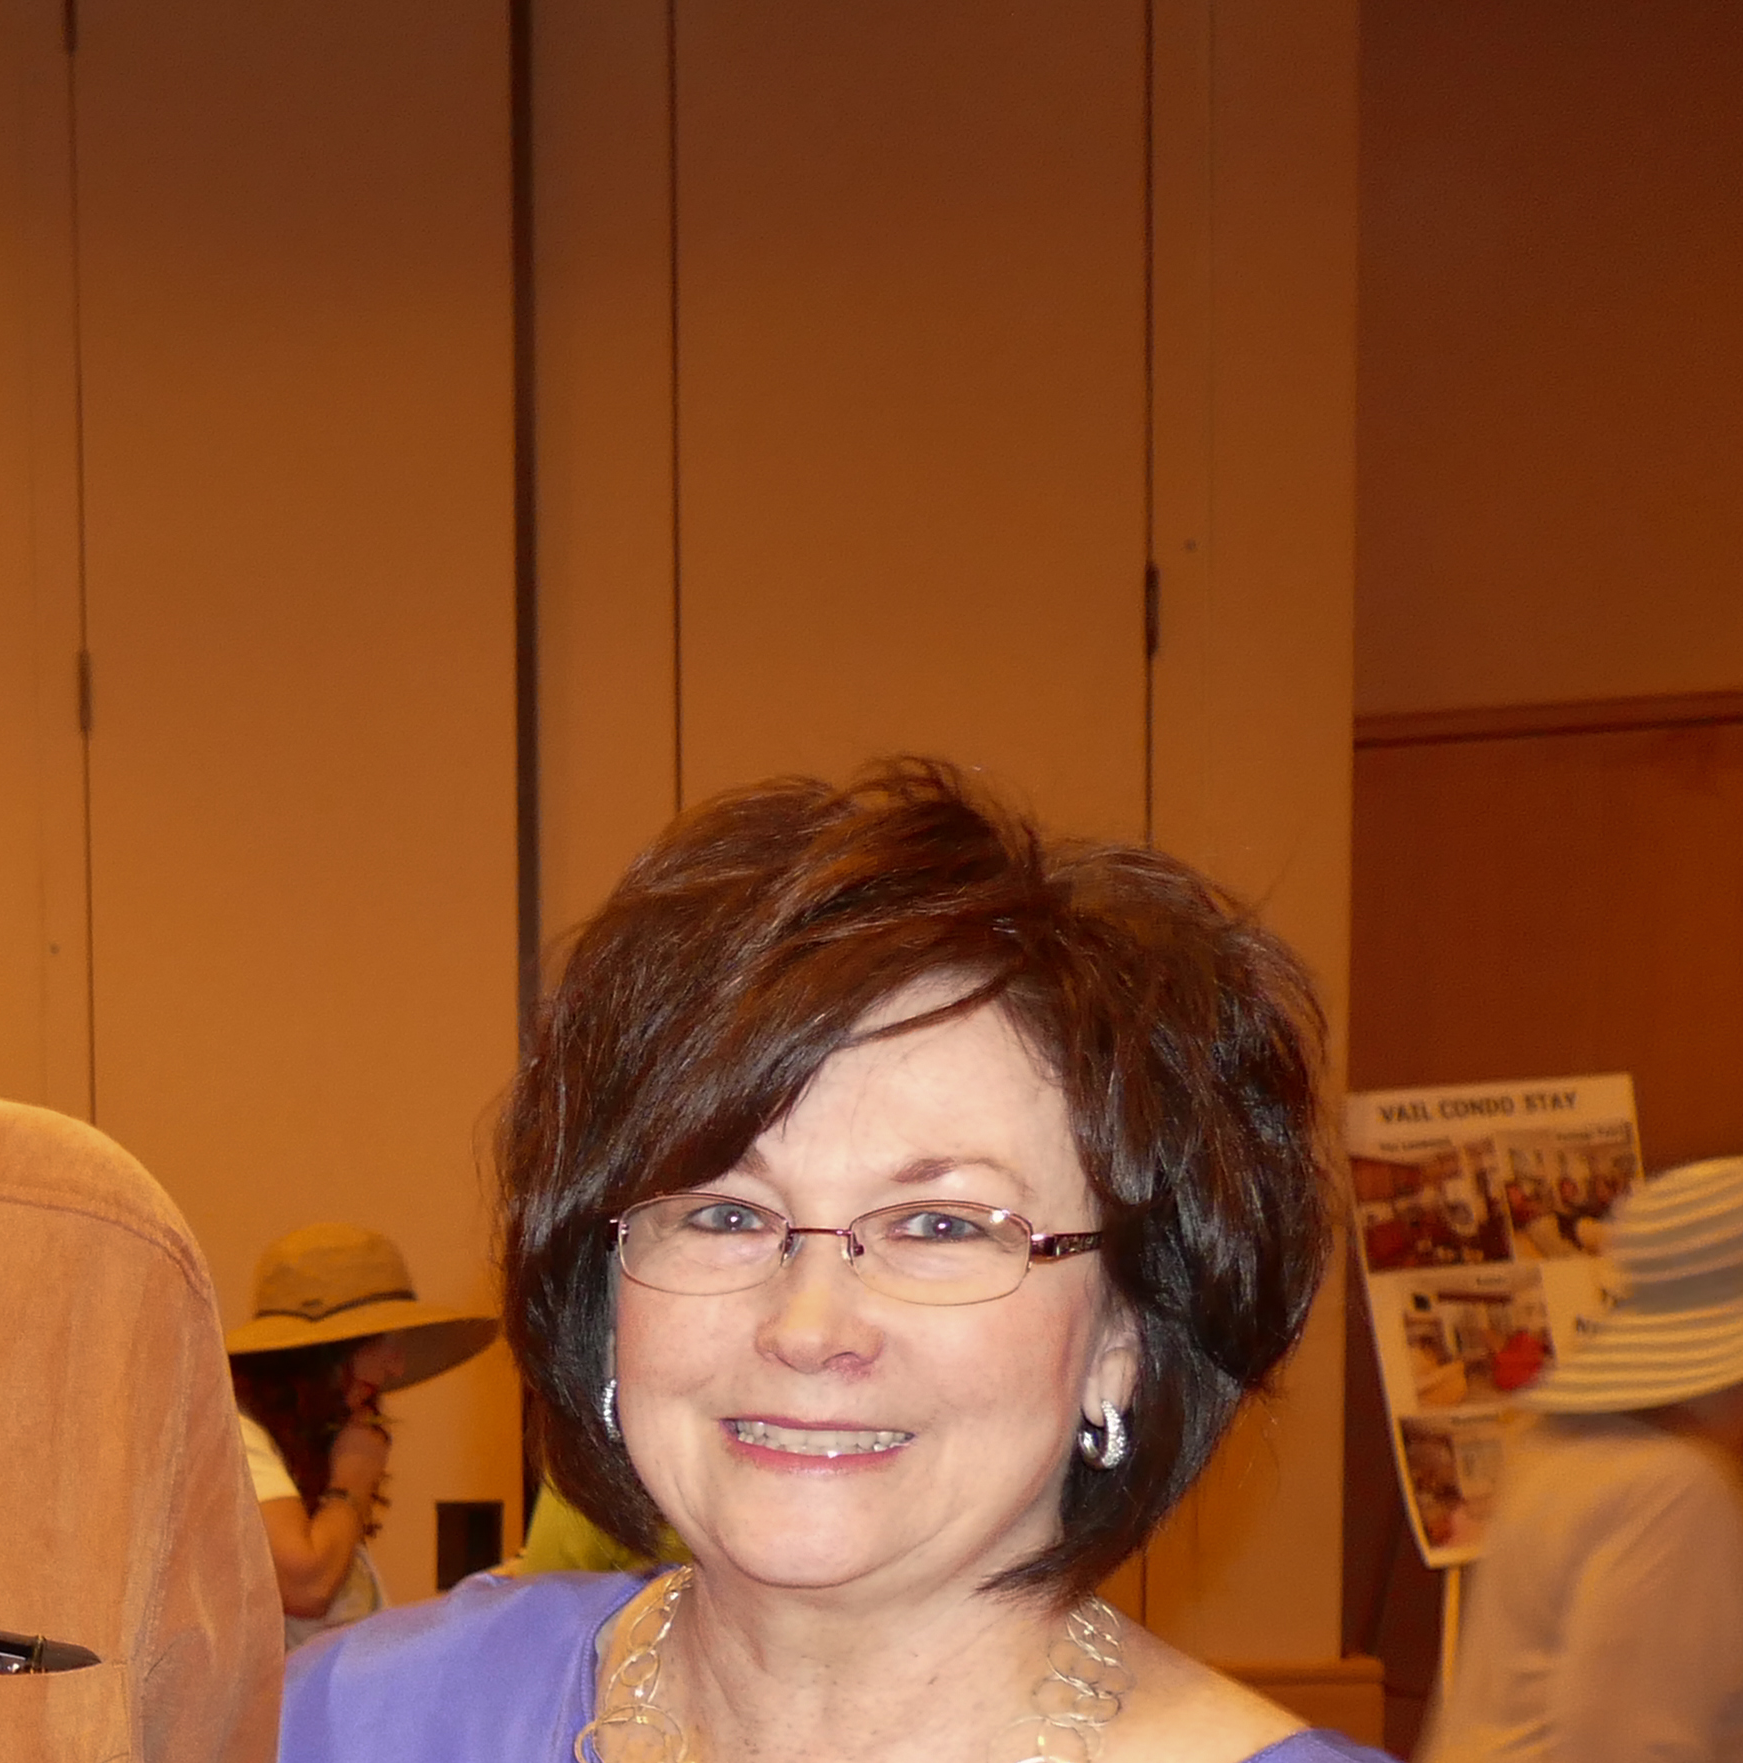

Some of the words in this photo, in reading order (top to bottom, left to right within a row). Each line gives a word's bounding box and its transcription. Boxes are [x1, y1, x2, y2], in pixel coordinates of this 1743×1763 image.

[1379, 1099, 1431, 1123] VAIL
[1438, 1095, 1514, 1120] CONDO
[1524, 1090, 1577, 1112] STAY
